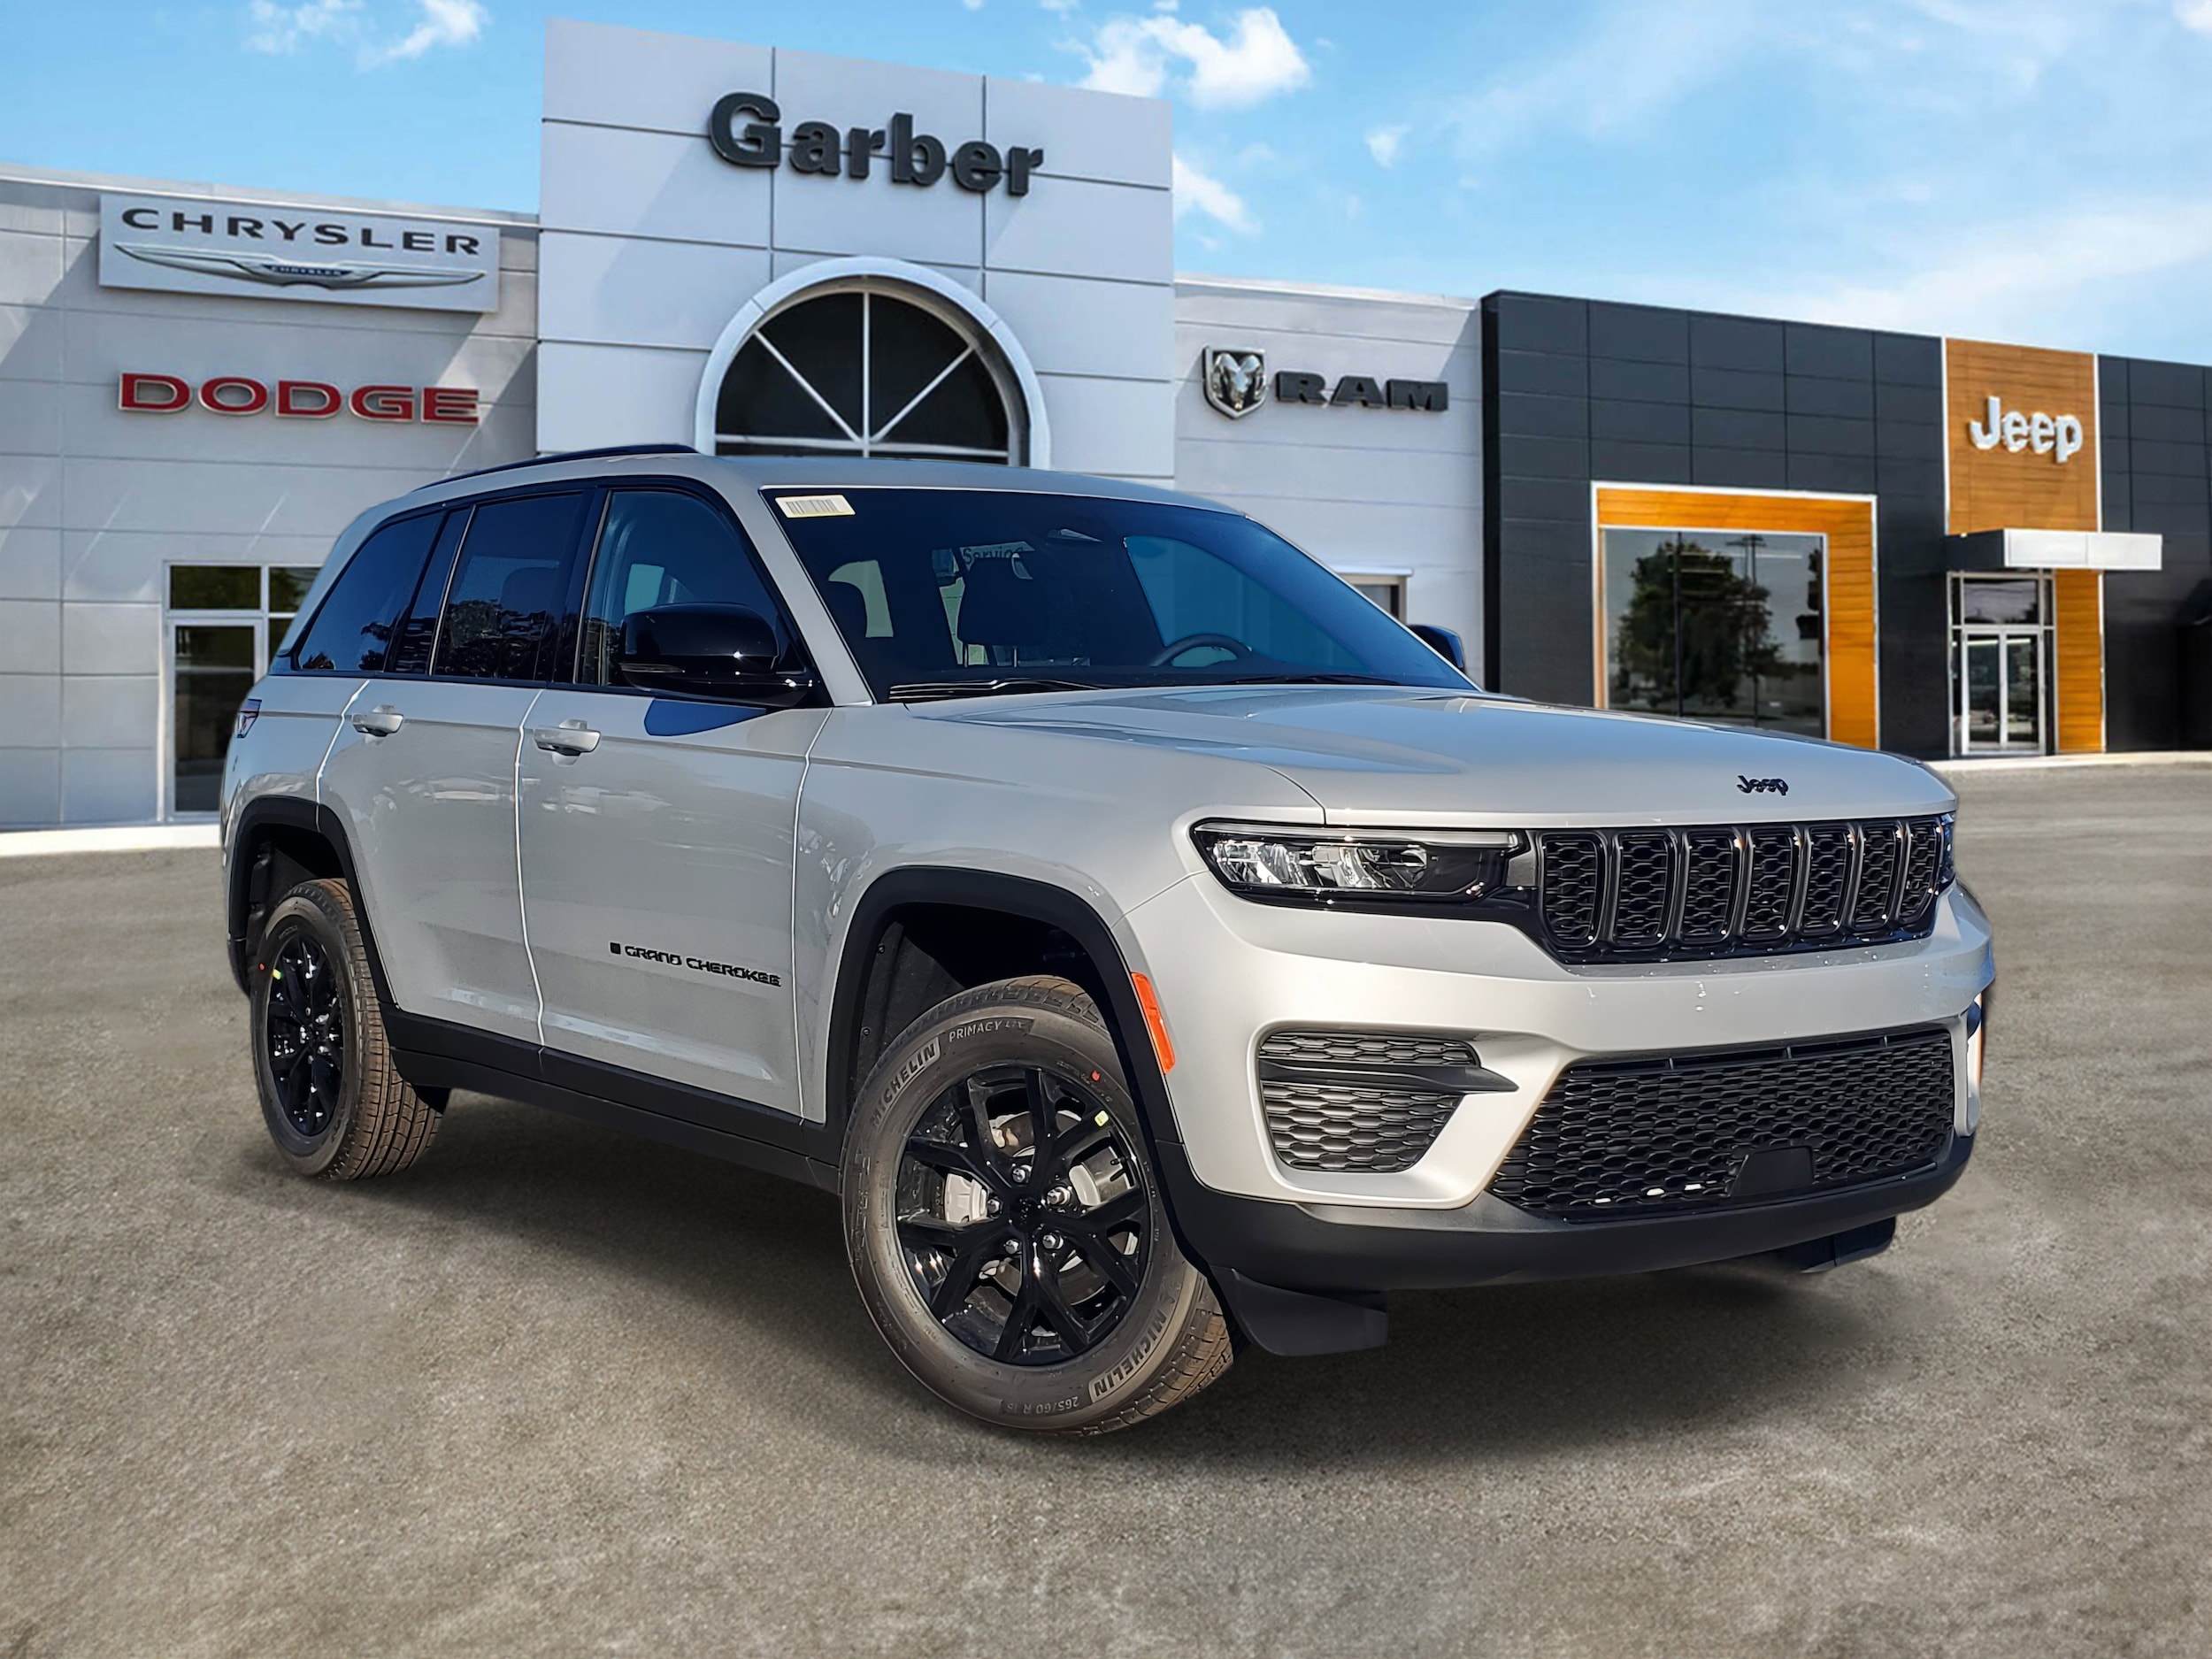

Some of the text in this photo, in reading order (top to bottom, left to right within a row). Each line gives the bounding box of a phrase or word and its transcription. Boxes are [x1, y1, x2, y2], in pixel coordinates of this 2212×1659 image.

[710, 92, 1044, 196] Garber
[121, 208, 480, 256] CHRYSLER
[118, 373, 480, 425] DODGE
[1275, 370, 1448, 412] RAM
[1969, 396, 2083, 464] Jeep
[1736, 774, 1789, 796] Jeep
[625, 945, 782, 987] GRAND CHEROKEE
[870, 1042, 935, 1127] MICHELIN
[949, 1019, 1002, 1042] PRIMACY
[1094, 1308, 1168, 1398] MICHELIN
